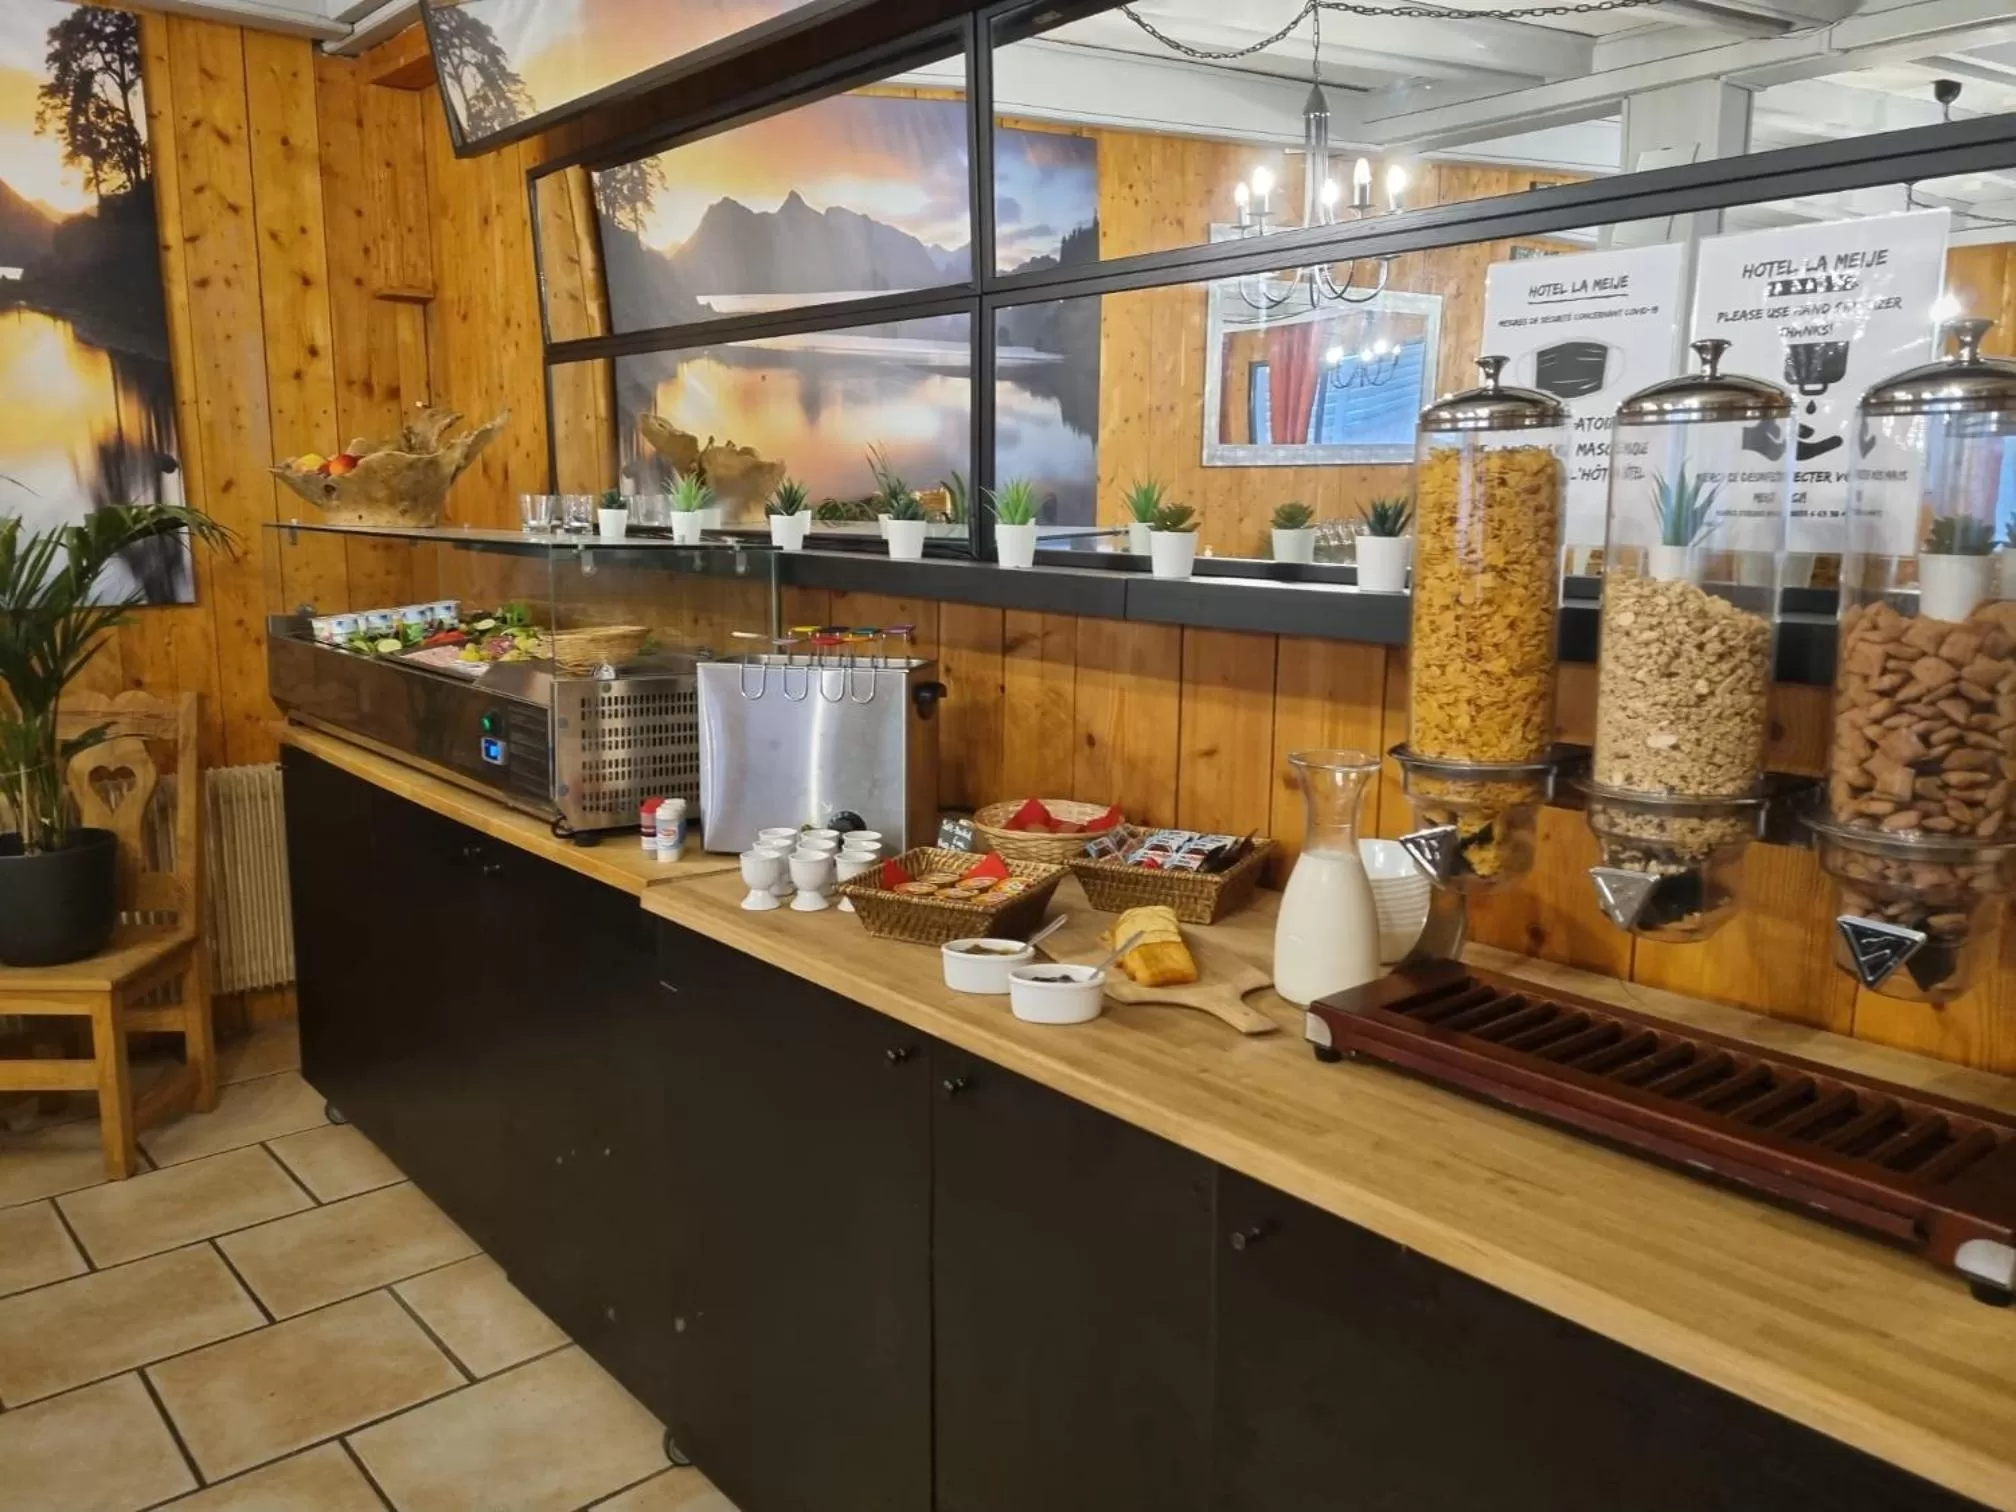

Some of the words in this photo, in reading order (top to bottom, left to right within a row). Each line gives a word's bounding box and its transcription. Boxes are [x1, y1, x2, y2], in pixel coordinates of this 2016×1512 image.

[1742, 259, 1799, 279] HOTEL
[1804, 255, 1828, 272] LA
[1834, 248, 1889, 271] MEIJE
[1528, 281, 1569, 298] HOTEL
[1571, 279, 1589, 294] LA
[1592, 274, 1630, 292] MEIJE
[1716, 307, 1764, 323] PLEASE
[1767, 304, 1790, 319] USE
